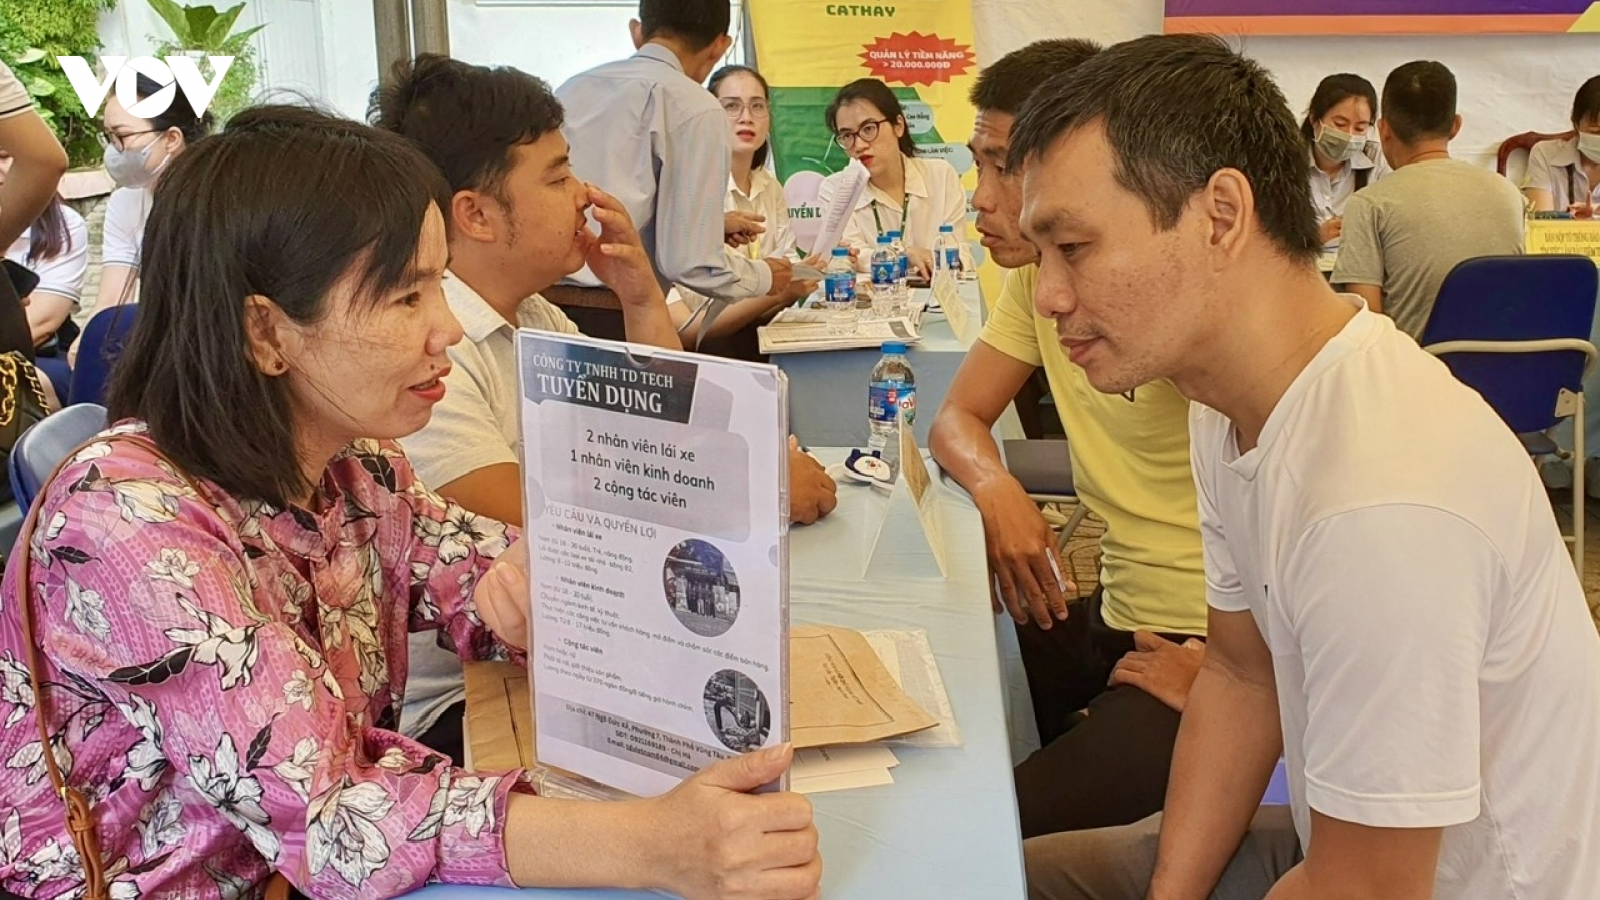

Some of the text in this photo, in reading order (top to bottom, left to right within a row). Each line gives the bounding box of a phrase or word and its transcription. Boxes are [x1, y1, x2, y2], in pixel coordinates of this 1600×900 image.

[826, 4, 896, 17] CATHAY
[870, 48, 896, 60] QUẢN
[912, 48, 934, 59] TIỀM
[934, 50, 964, 59] NĂNG
[787, 202, 814, 218] UYỂN
[534, 353, 674, 388] CÔNG TY TNHH TD TECH
[537, 374, 662, 414] TUYỂN DỤNG
[586, 429, 696, 462] 2 nhân viên lái xe
[570, 449, 715, 491] 1 nhân viên kinh doanh
[594, 476, 687, 508] 2 cộng tác viên
[544, 504, 562, 517] YÊU
[586, 514, 602, 526] VÀ
[604, 518, 638, 535] QUYỀN
[640, 526, 657, 540] LỢI
